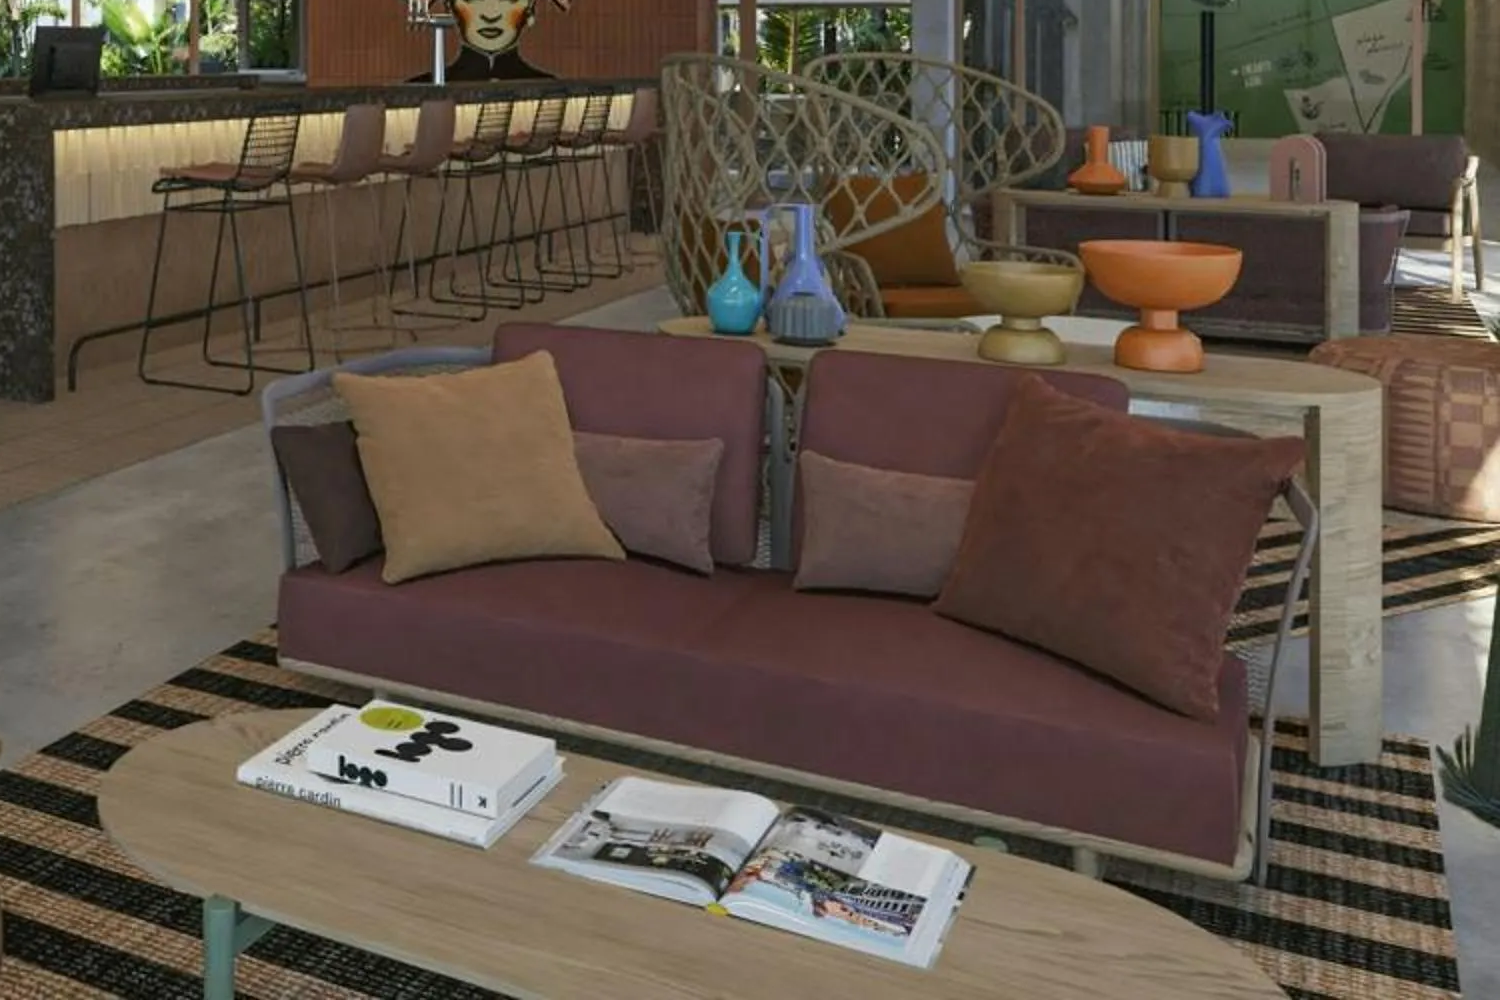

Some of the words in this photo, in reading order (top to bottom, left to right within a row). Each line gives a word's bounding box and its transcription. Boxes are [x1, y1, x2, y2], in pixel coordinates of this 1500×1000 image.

[337, 754, 388, 788] logo
[254, 775, 295, 798] pierre
[299, 788, 342, 808] cardin
